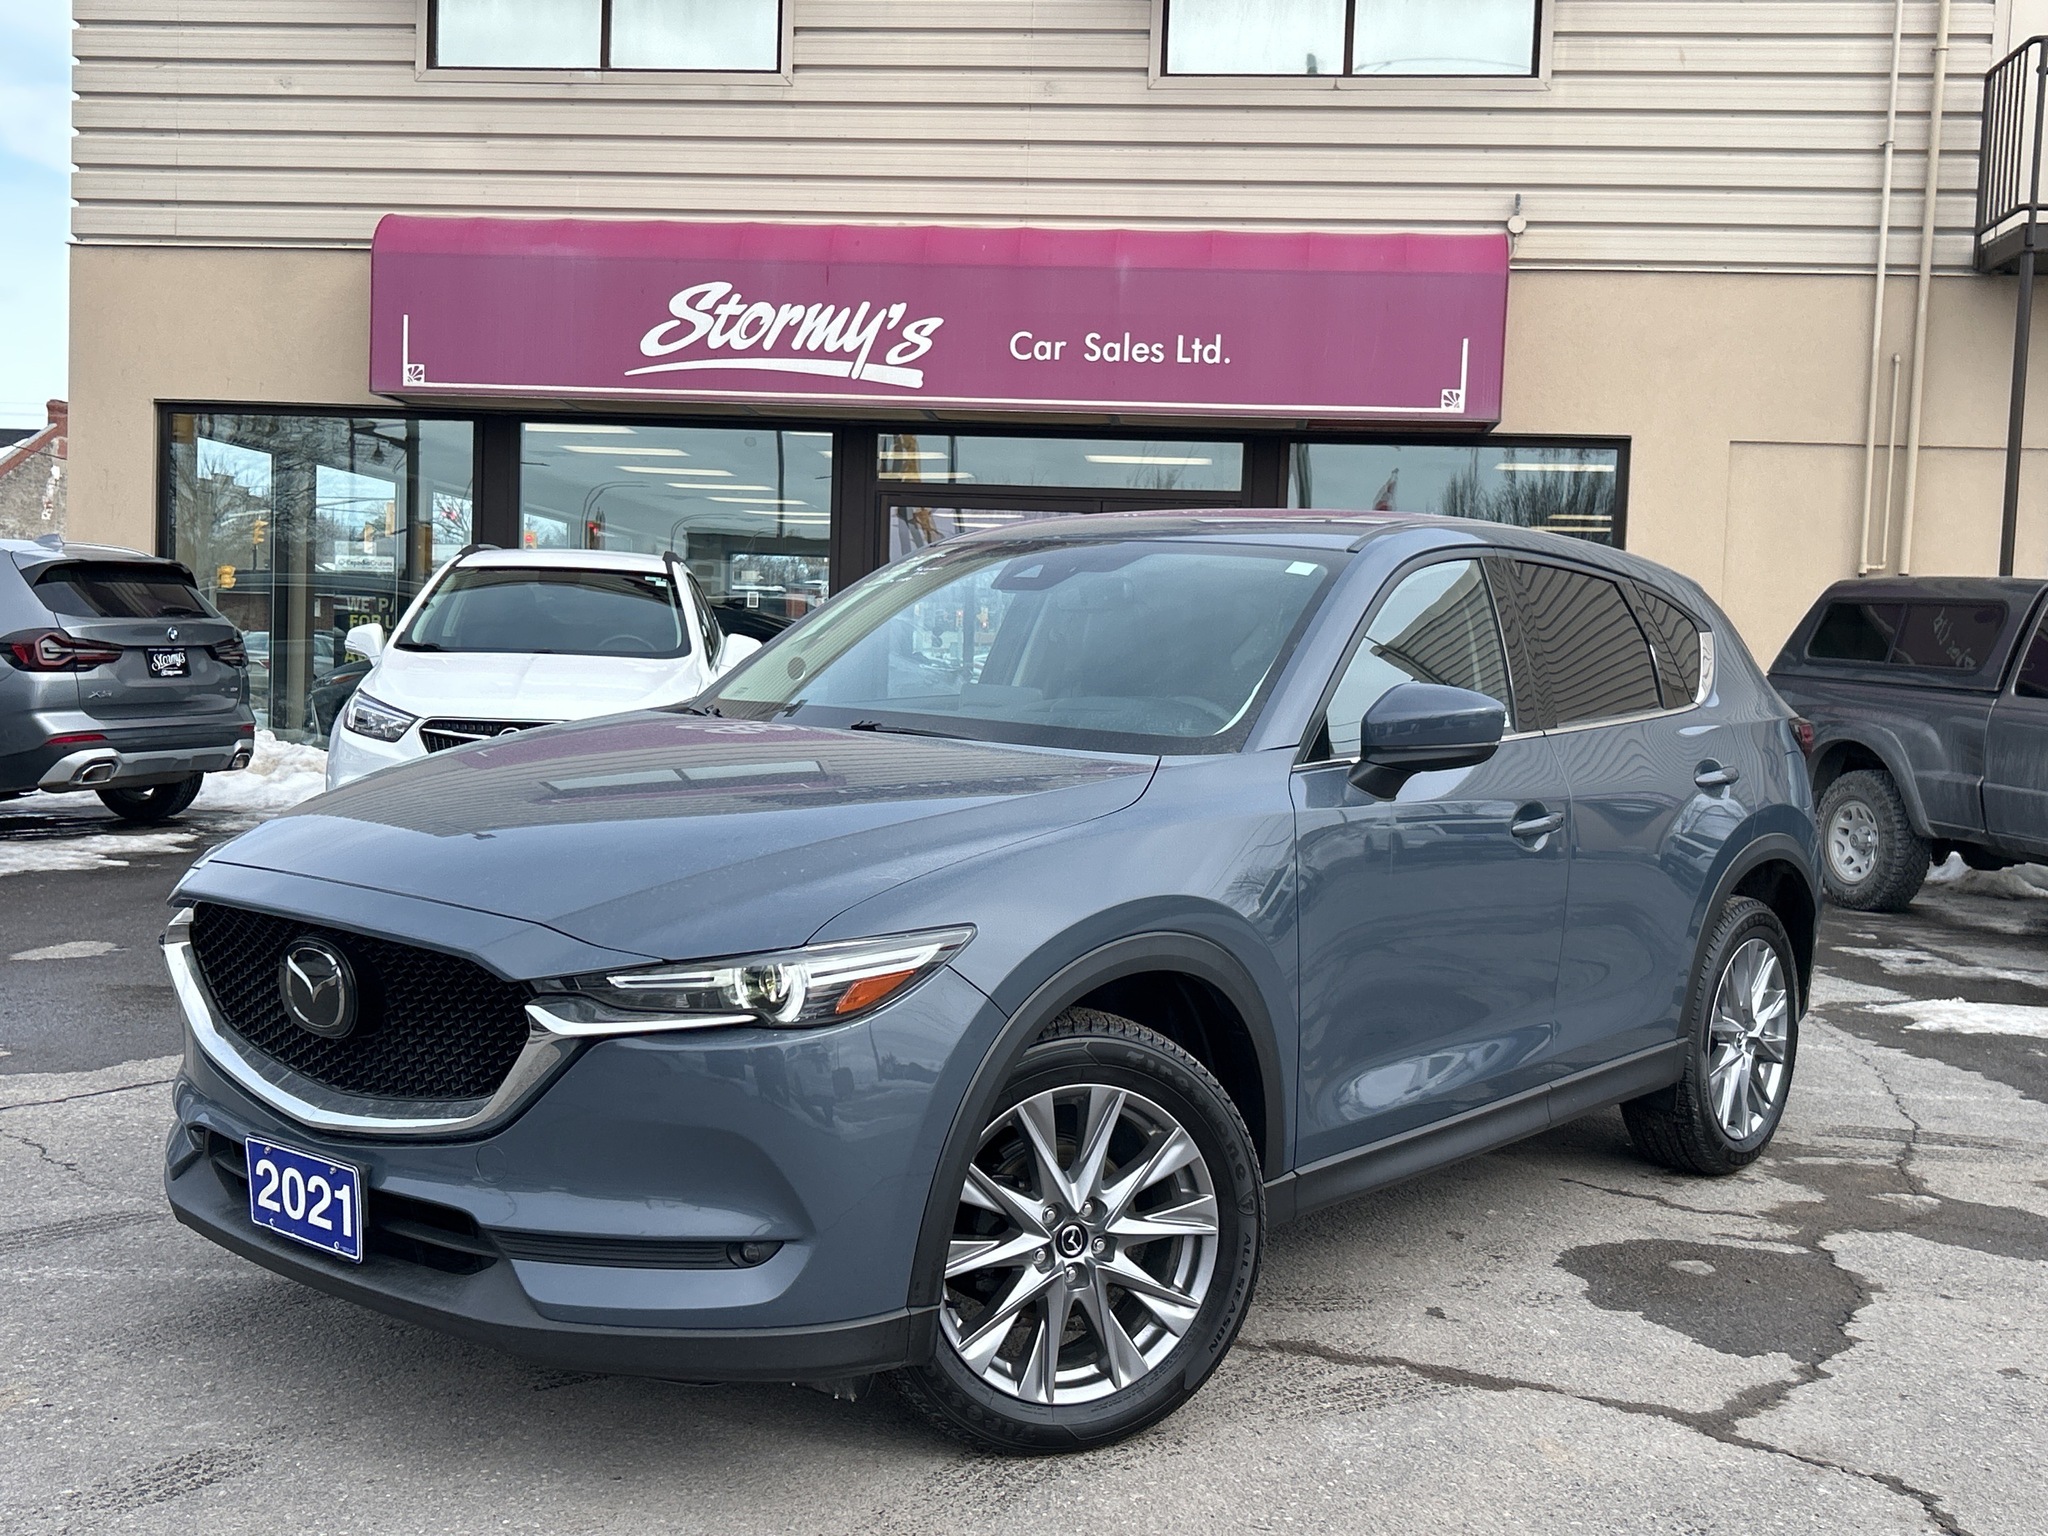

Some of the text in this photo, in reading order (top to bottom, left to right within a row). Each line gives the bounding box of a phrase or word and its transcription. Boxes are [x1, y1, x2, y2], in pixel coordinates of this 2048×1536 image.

[640, 281, 945, 380] Stormy's
[1009, 331, 1232, 364] Car Sales Ltd.
[347, 597, 370, 612] WE
[255, 1158, 352, 1237] 2021
[1239, 1232, 1252, 1271] ALL
[1209, 1277, 1245, 1354] SEASON
